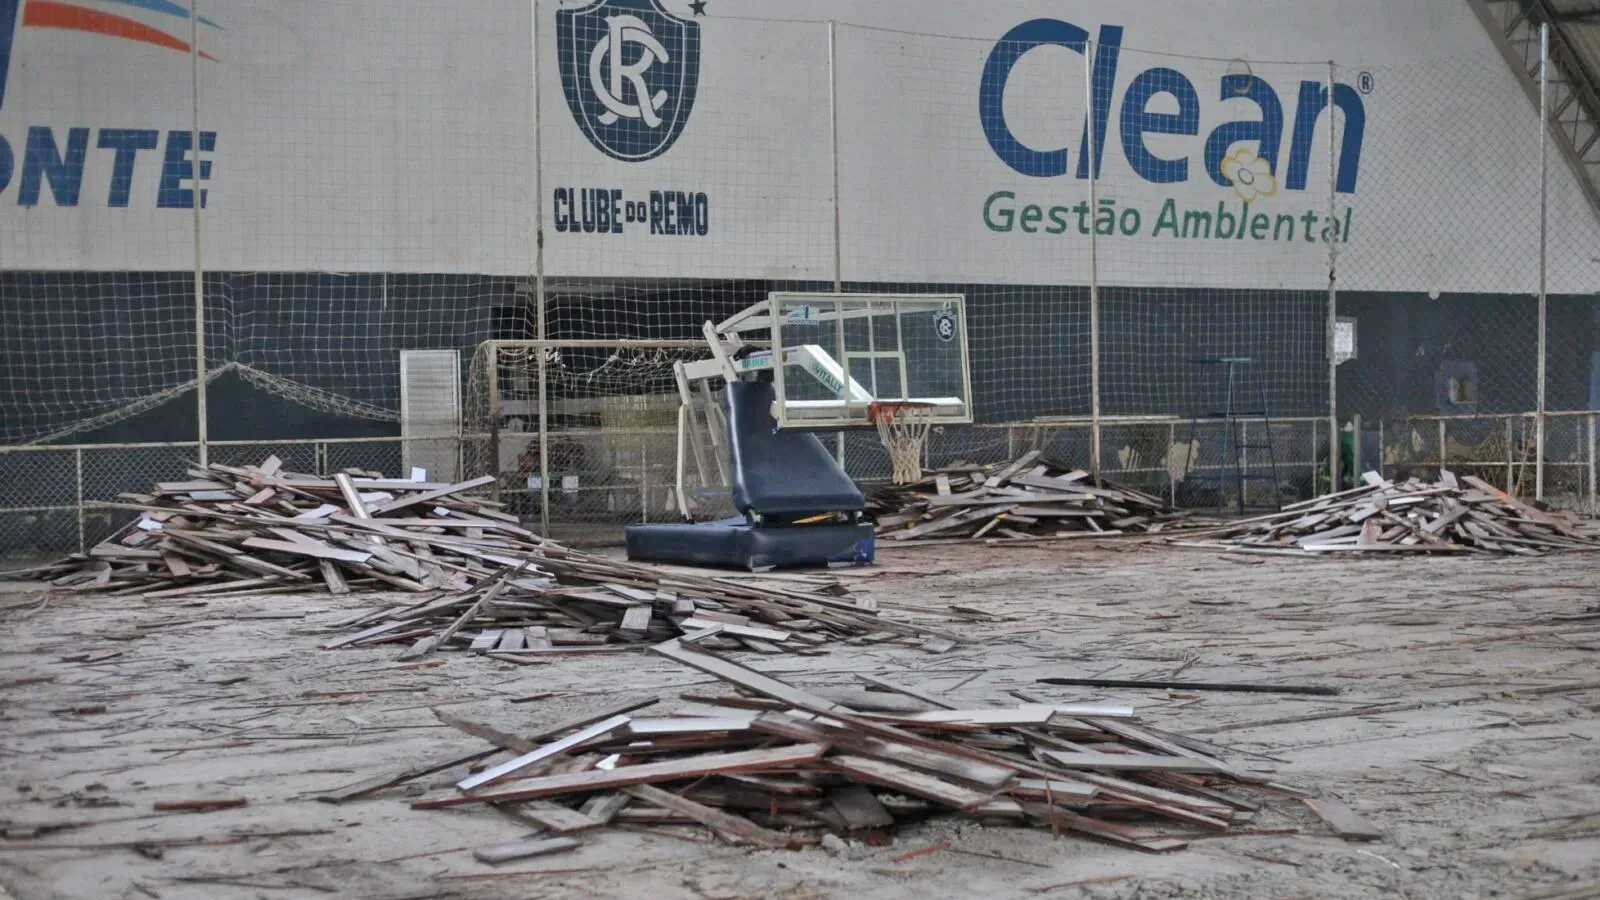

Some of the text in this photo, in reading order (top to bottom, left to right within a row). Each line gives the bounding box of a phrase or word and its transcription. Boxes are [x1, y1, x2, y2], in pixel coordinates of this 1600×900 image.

[979, 17, 1365, 194] Clean
[553, 187, 709, 236] CLUBE DO REMO
[982, 190, 1141, 236] Gestão
[815, 361, 844, 392] VITALLY
